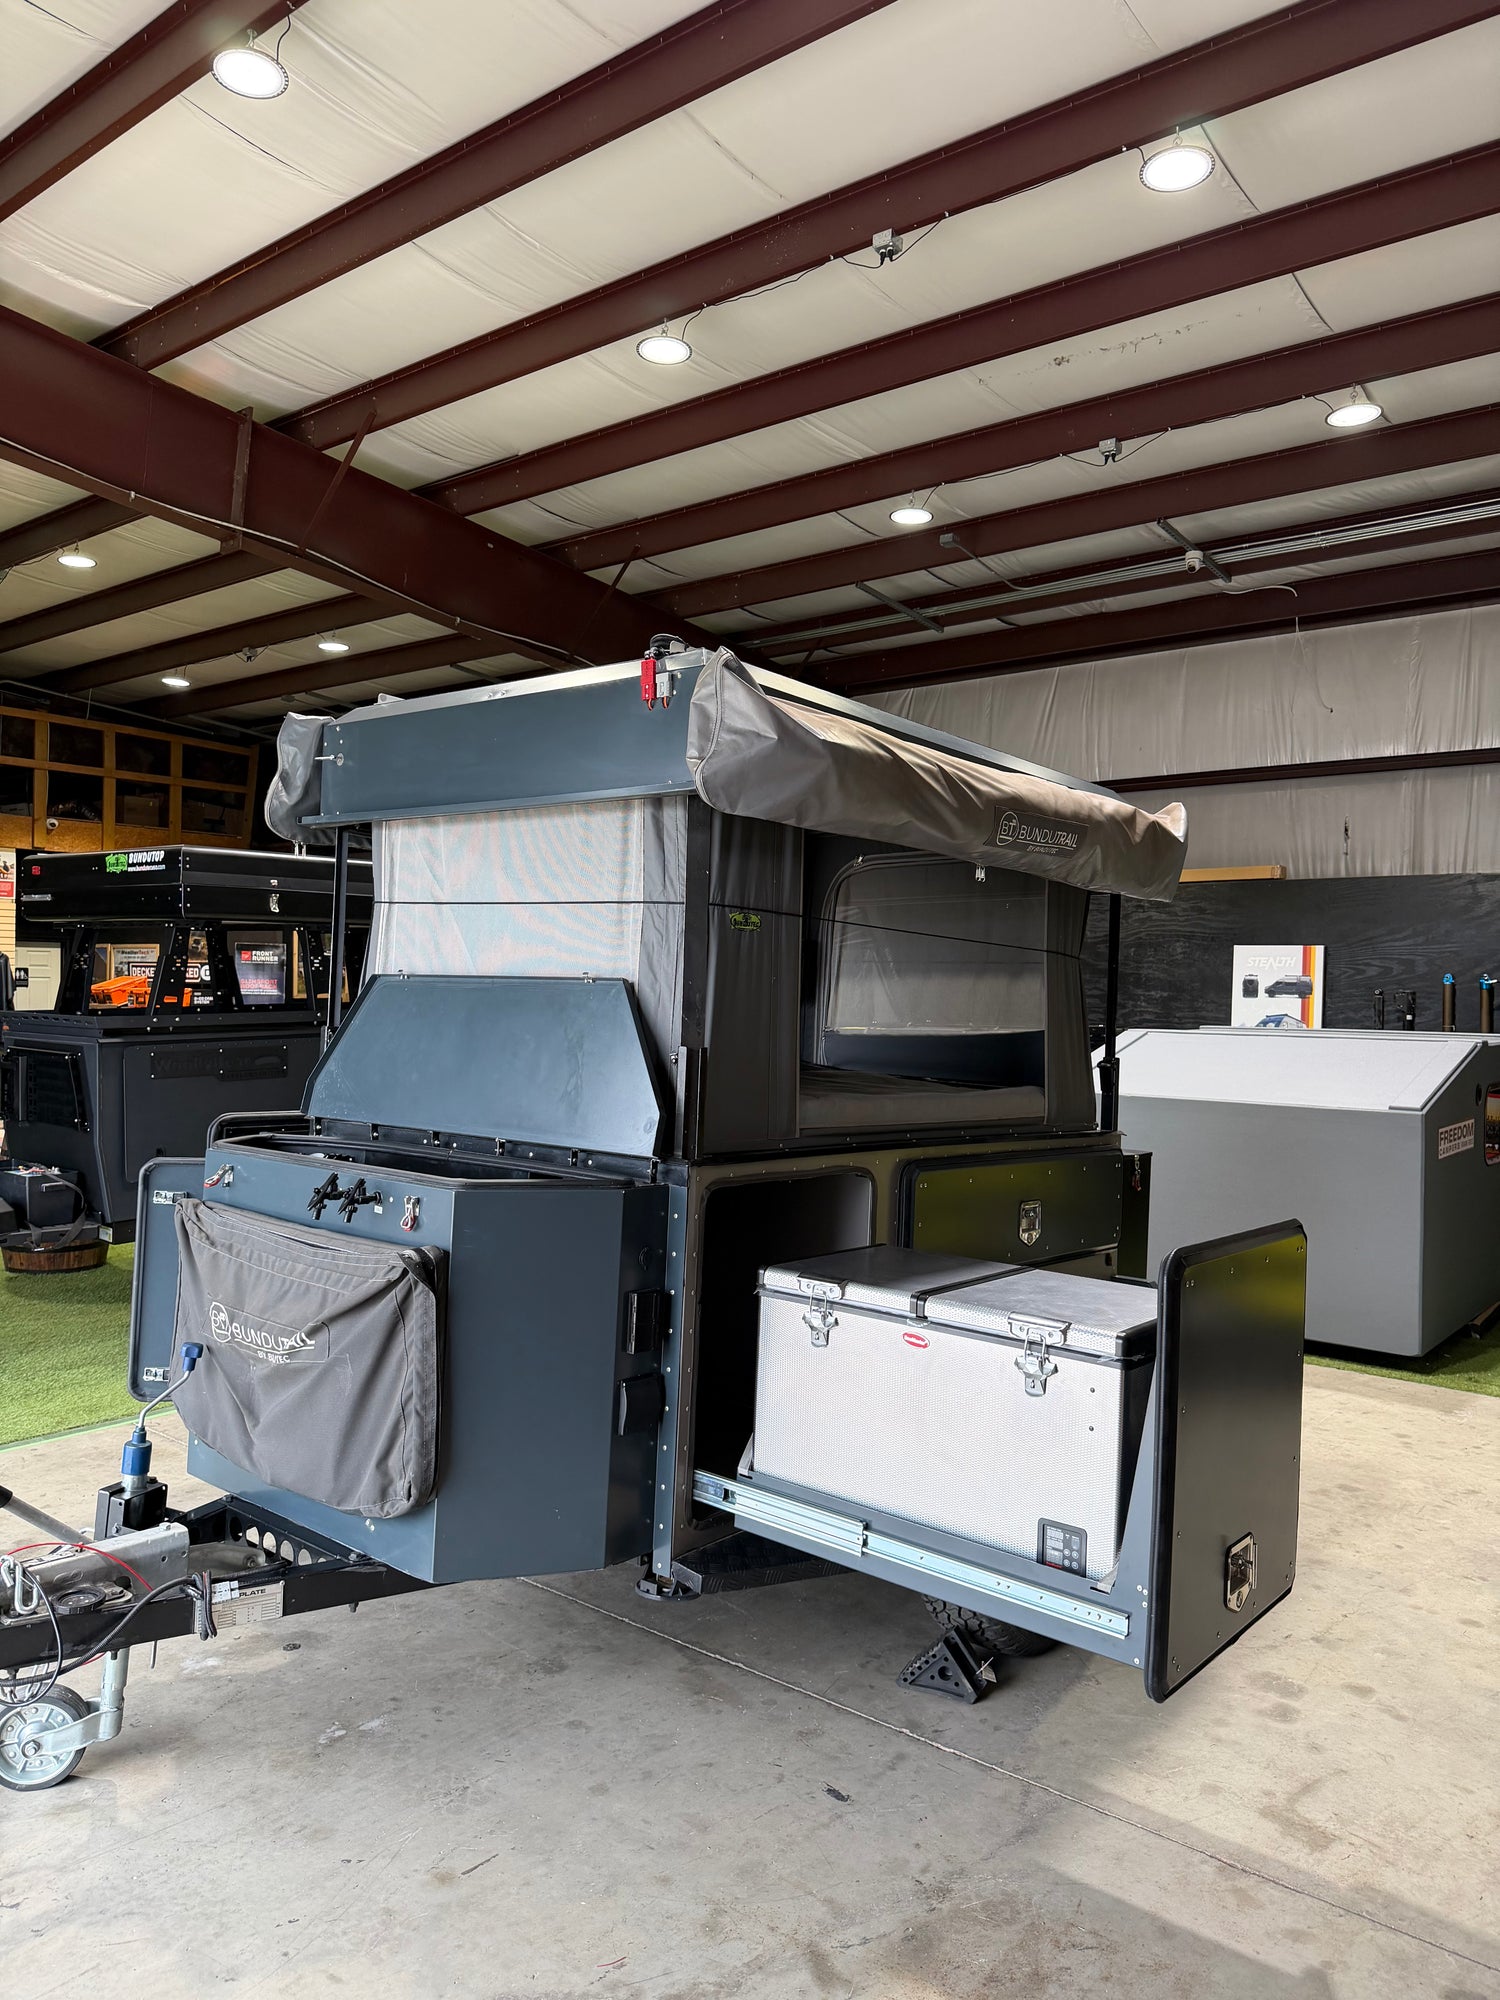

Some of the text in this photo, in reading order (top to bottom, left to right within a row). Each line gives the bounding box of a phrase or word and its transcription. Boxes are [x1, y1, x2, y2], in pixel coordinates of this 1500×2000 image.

[1019, 825, 1078, 848] BUNDUTRAIL
[129, 850, 165, 864] BUNDUTOP
[1247, 957, 1296, 970] STEALTH
[132, 967, 155, 977] DECKE
[1439, 1122, 1474, 1147] FREEDOM
[239, 1588, 267, 1598] PLATE
